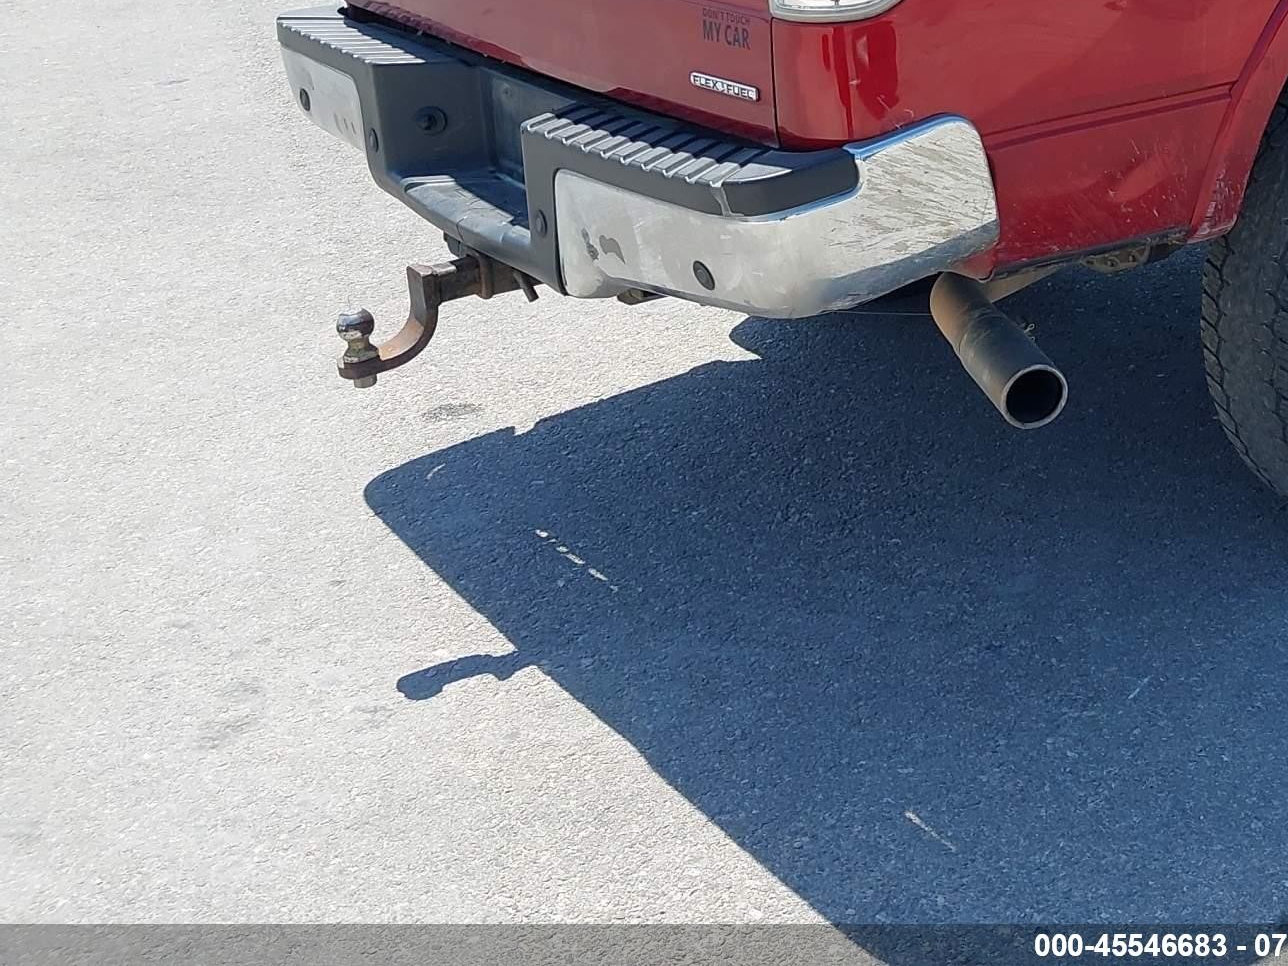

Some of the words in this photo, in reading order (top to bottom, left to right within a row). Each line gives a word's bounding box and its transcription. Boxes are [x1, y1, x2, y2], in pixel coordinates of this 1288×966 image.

[725, 12, 750, 26] TOUCH
[703, 20, 721, 42] MY
[725, 24, 751, 50] CAR
[693, 75, 719, 90] FLEX
[726, 83, 756, 101] FUEL
